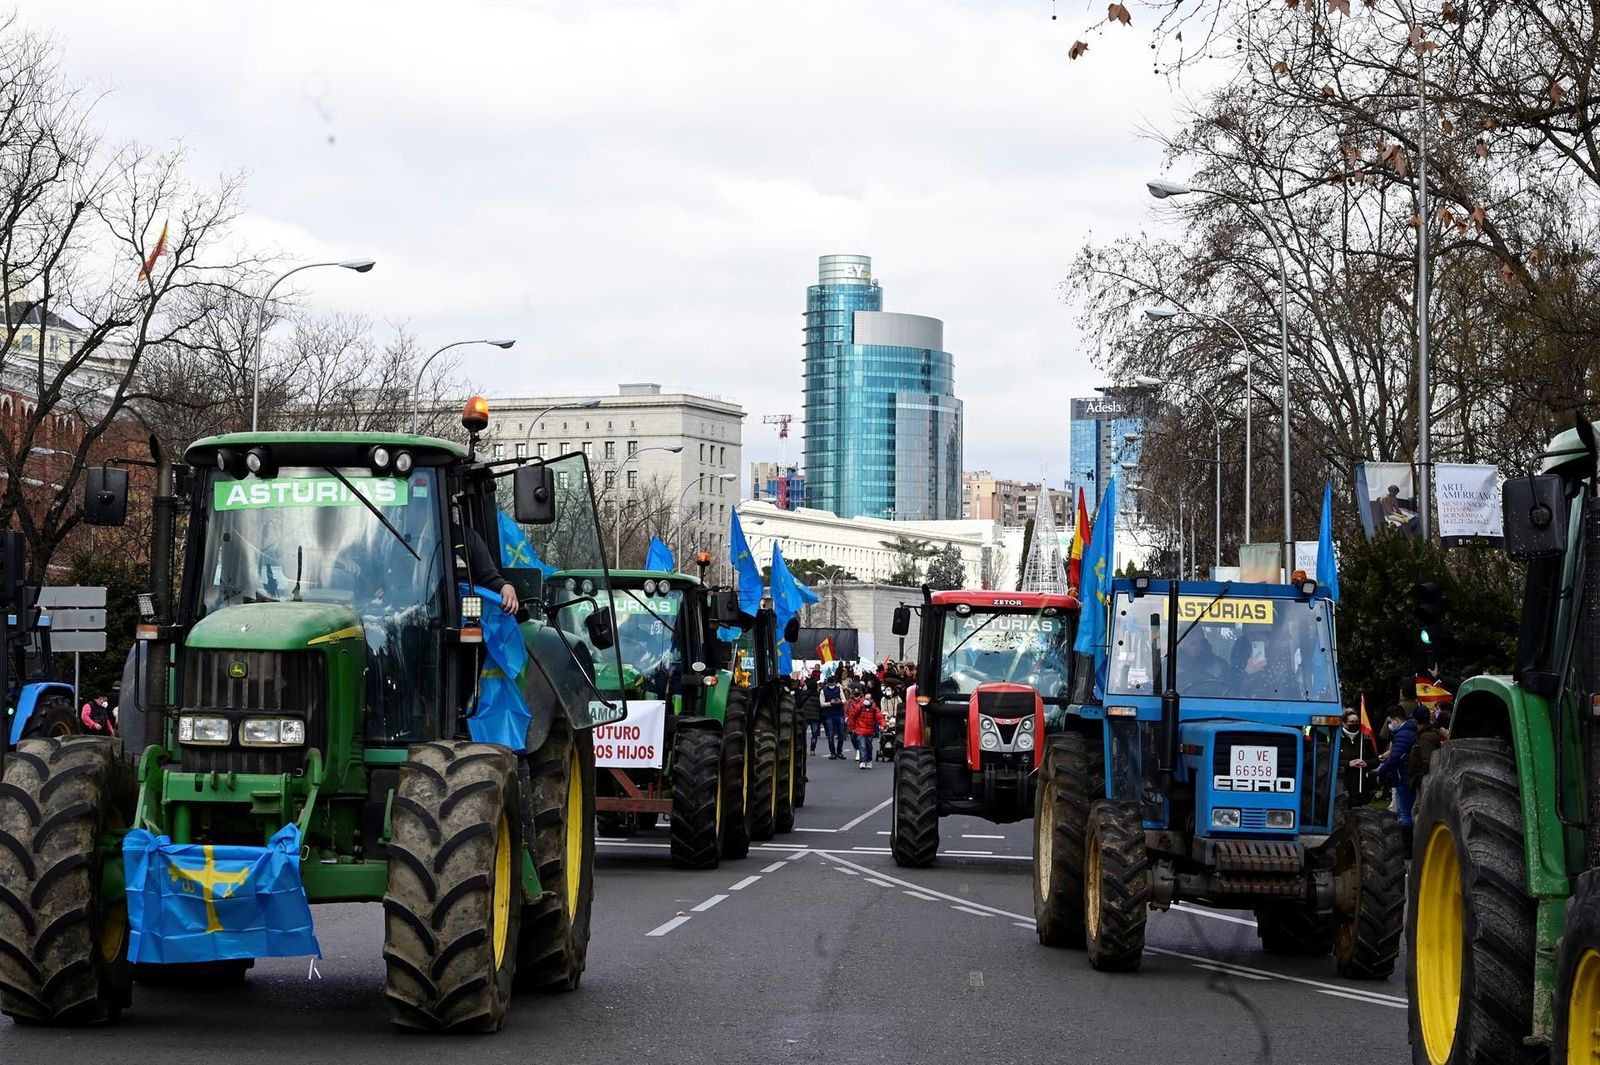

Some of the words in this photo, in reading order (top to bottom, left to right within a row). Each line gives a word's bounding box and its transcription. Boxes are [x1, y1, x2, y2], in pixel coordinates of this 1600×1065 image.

[225, 480, 397, 506] ASTURIAS
[1441, 483, 1466, 491] ARTE
[1441, 491, 1497, 501] AMERICANO
[963, 617, 1053, 632] ASTURIAS
[592, 726, 640, 740] UTURO
[592, 744, 613, 759] OS
[617, 745, 654, 759] HIJOS
[1256, 750, 1269, 762] VE
[1235, 765, 1272, 777] 66358
[1213, 775, 1295, 793] EBRO
